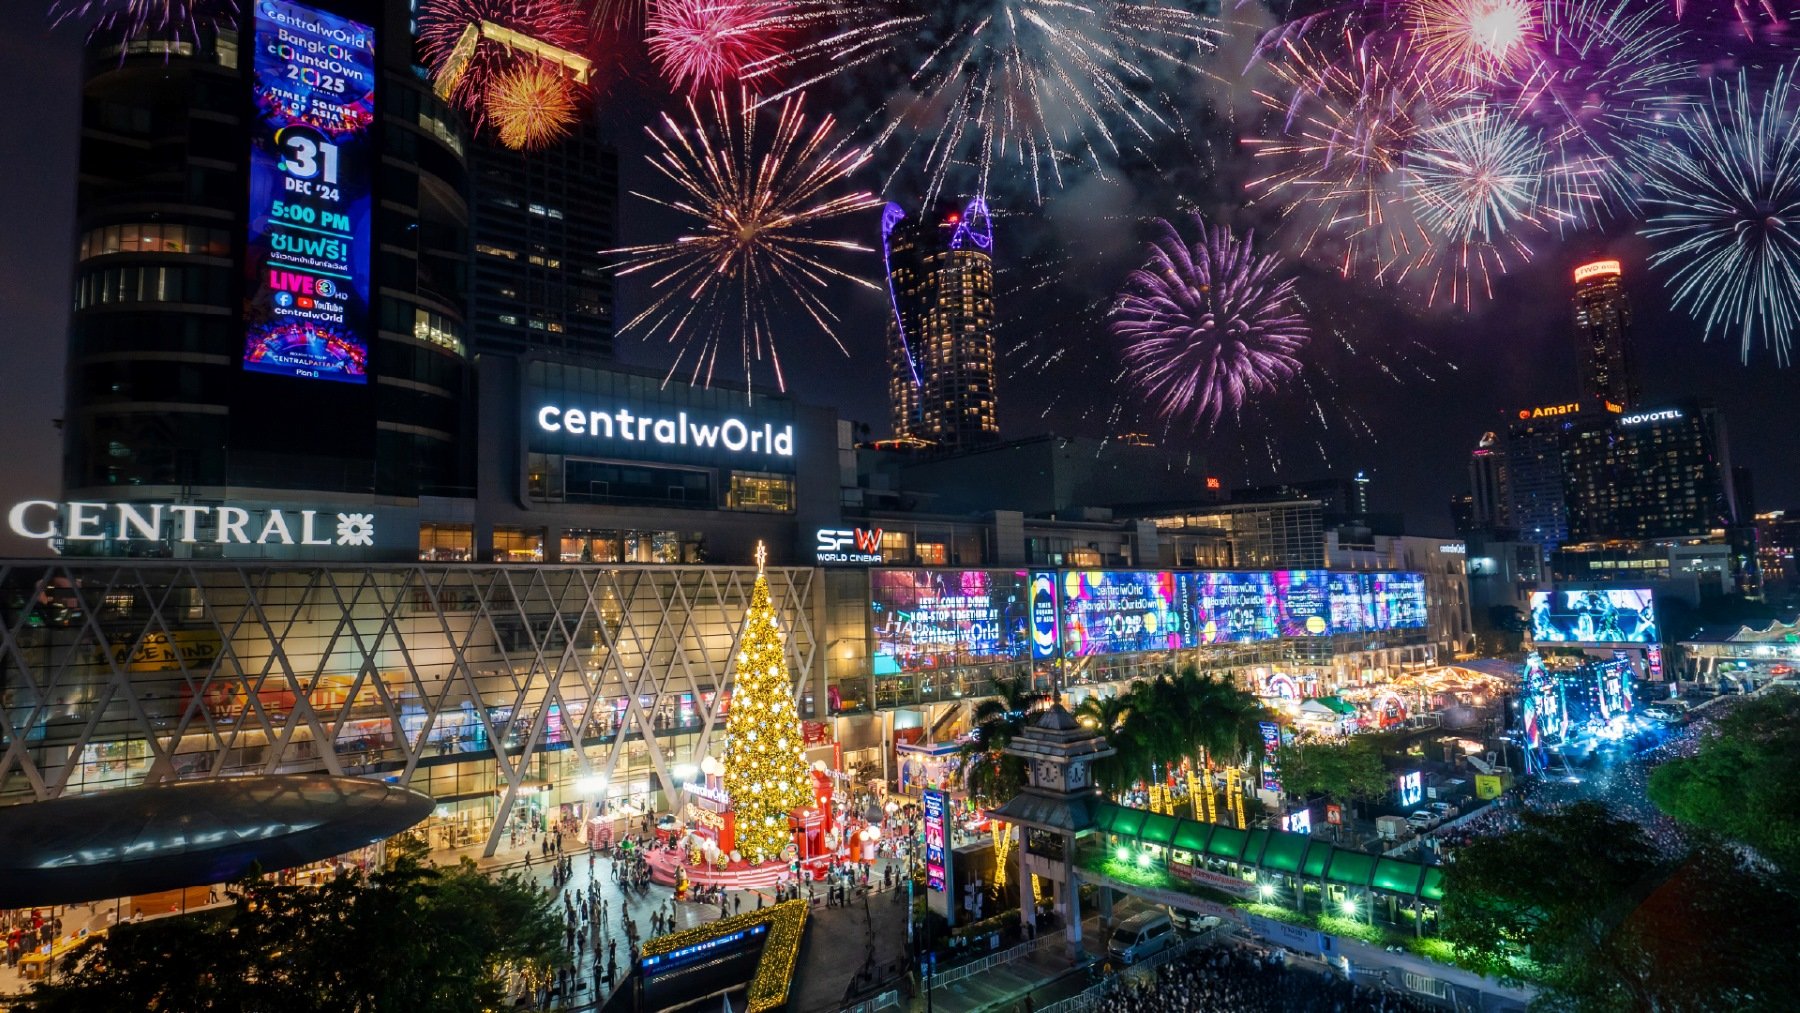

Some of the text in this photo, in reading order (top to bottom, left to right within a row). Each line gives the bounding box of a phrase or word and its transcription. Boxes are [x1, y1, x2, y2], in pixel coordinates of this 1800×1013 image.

[268, 10, 364, 48] centralwOrld
[279, 29, 352, 62] BangkOk
[268, 44, 363, 80] cOuntdOwn
[288, 65, 344, 93] 2025
[271, 87, 357, 118] TIMES SQUARE
[291, 102, 339, 121] OF ASIA
[286, 136, 338, 184] 31
[286, 177, 311, 195] DEC
[272, 200, 350, 231] 5:00 PM
[271, 233, 347, 261] ชมฟรี!
[270, 270, 314, 295] LIVE
[335, 292, 348, 300] HD
[274, 307, 343, 323] centralwOrld
[313, 300, 343, 313] YouTube
[1532, 402, 1580, 418] Amari
[1622, 410, 1683, 425] NOVOTEL
[538, 405, 793, 456] centralwOrld
[8, 500, 332, 554] CENTRAL
[816, 553, 882, 563] WORLD CINEMA
[414, 591, 457, 612] TRND
[910, 609, 998, 623] NON-STOP TOGETHER AT
